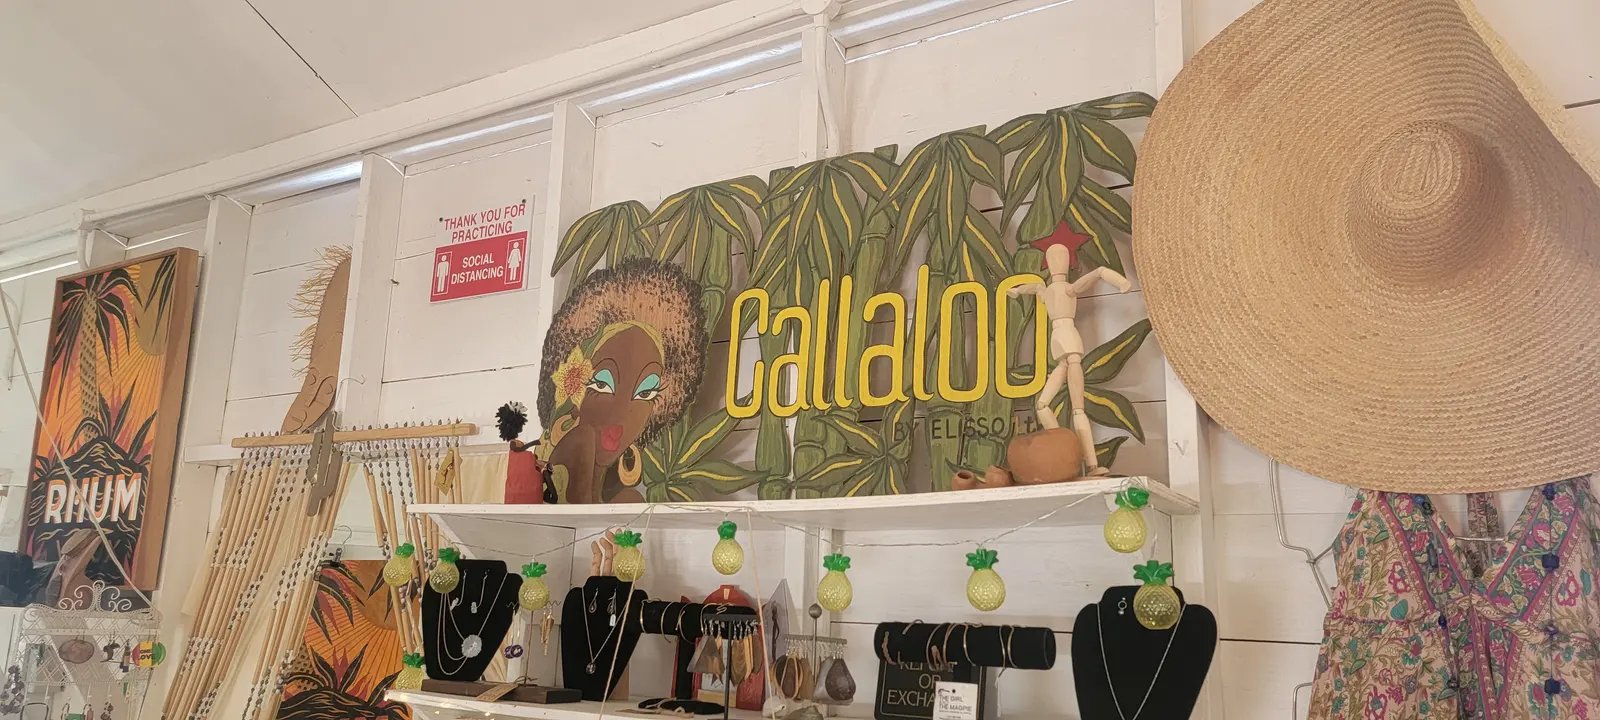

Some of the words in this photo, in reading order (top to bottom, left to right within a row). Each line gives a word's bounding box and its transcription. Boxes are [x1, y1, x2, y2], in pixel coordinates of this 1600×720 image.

[444, 213, 477, 231] THANK
[480, 207, 501, 224] YOU
[504, 203, 525, 219] FOR
[451, 220, 513, 244] PRACTICING
[462, 253, 494, 269] SOCIAL
[451, 265, 504, 285] DISTANCING
[725, 263, 1048, 419] Callaloo
[894, 421, 919, 442] BY
[931, 416, 1005, 440] ELISSO
[43, 472, 142, 524] RHUM
[887, 690, 935, 708] EXCHA
